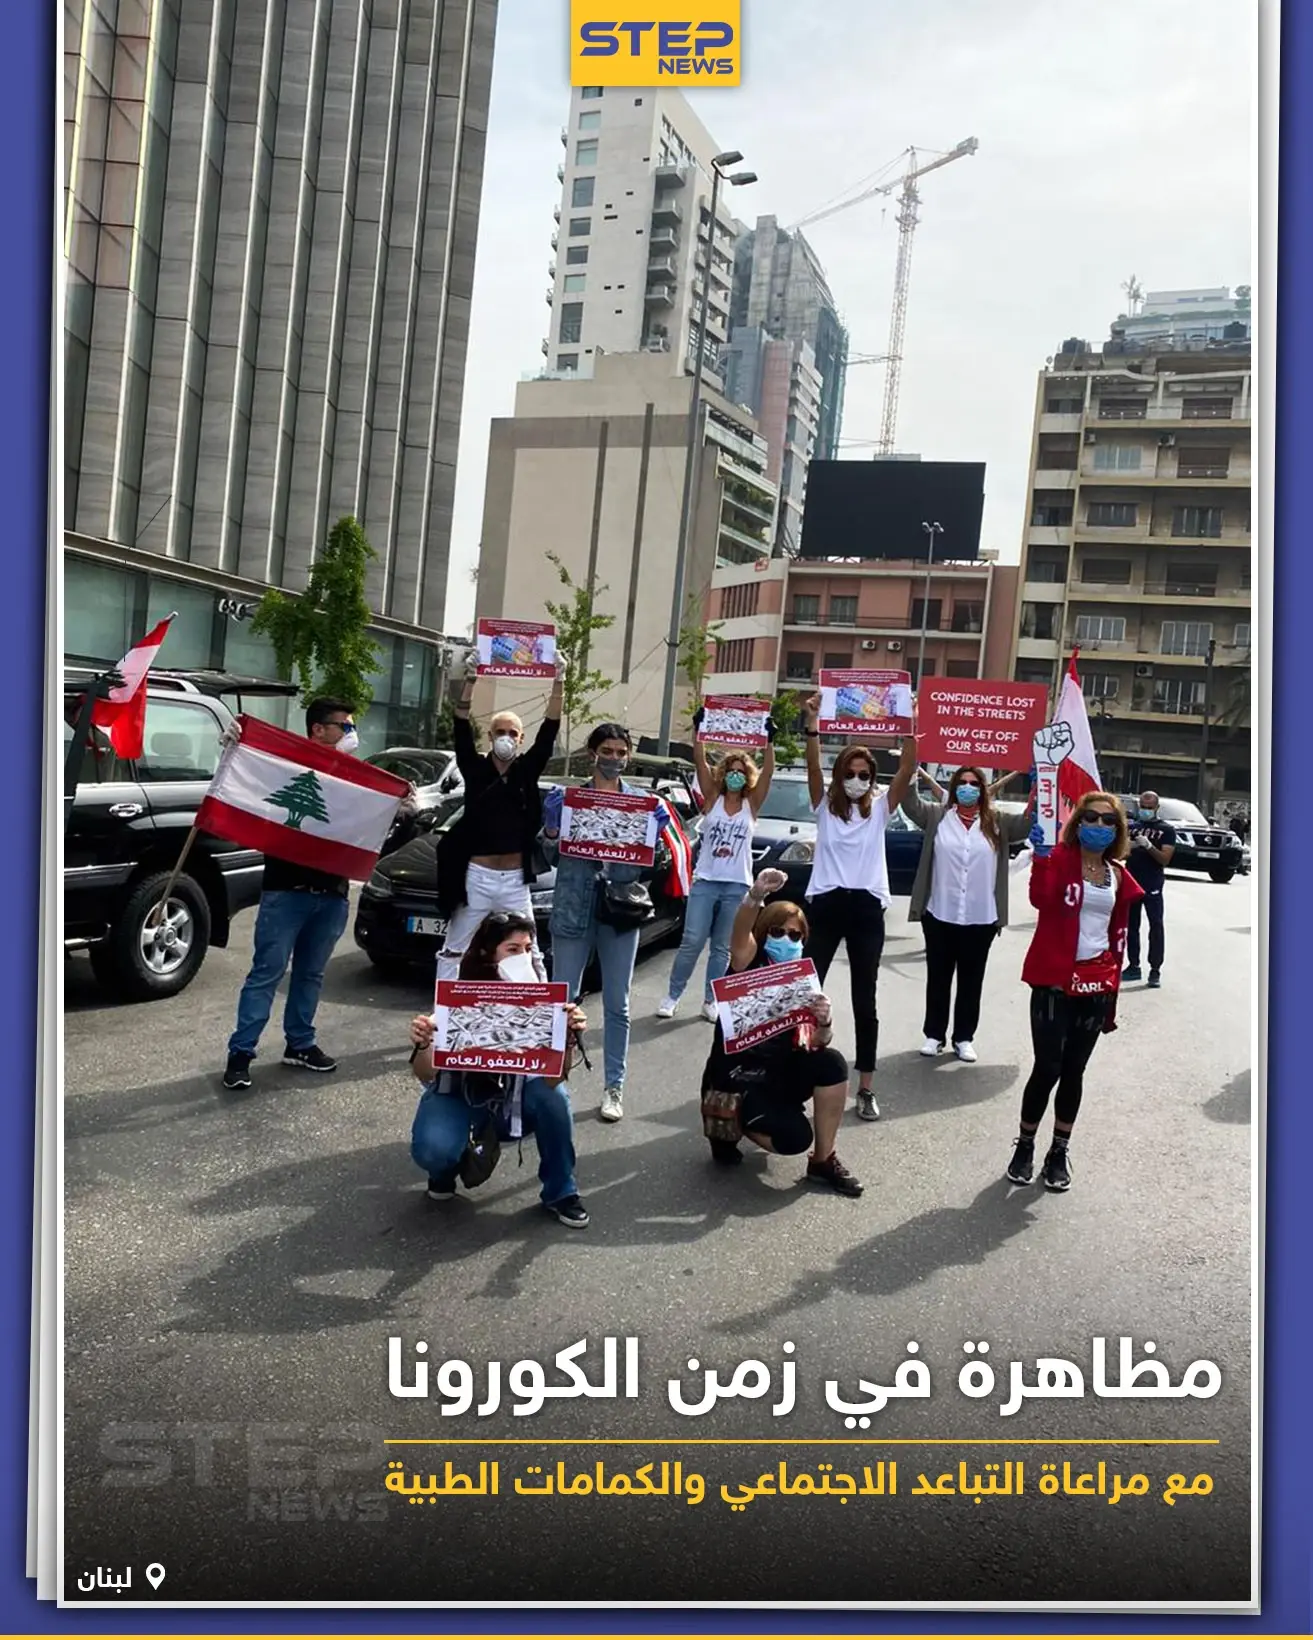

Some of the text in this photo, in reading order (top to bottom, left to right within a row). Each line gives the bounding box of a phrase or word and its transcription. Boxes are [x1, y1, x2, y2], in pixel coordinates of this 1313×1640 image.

[930, 691, 1036, 708] CONFIDENCE LOST
[937, 705, 1027, 721] IN THE STREETS
[939, 727, 1020, 742] NOW GET OFF
[946, 740, 1009, 754] OUR SEATS
[567, 844, 642, 861] لا_للعفو_العام
[415, 918, 448, 935] A 32
[735, 1014, 810, 1050] لا_للعفو_العام
